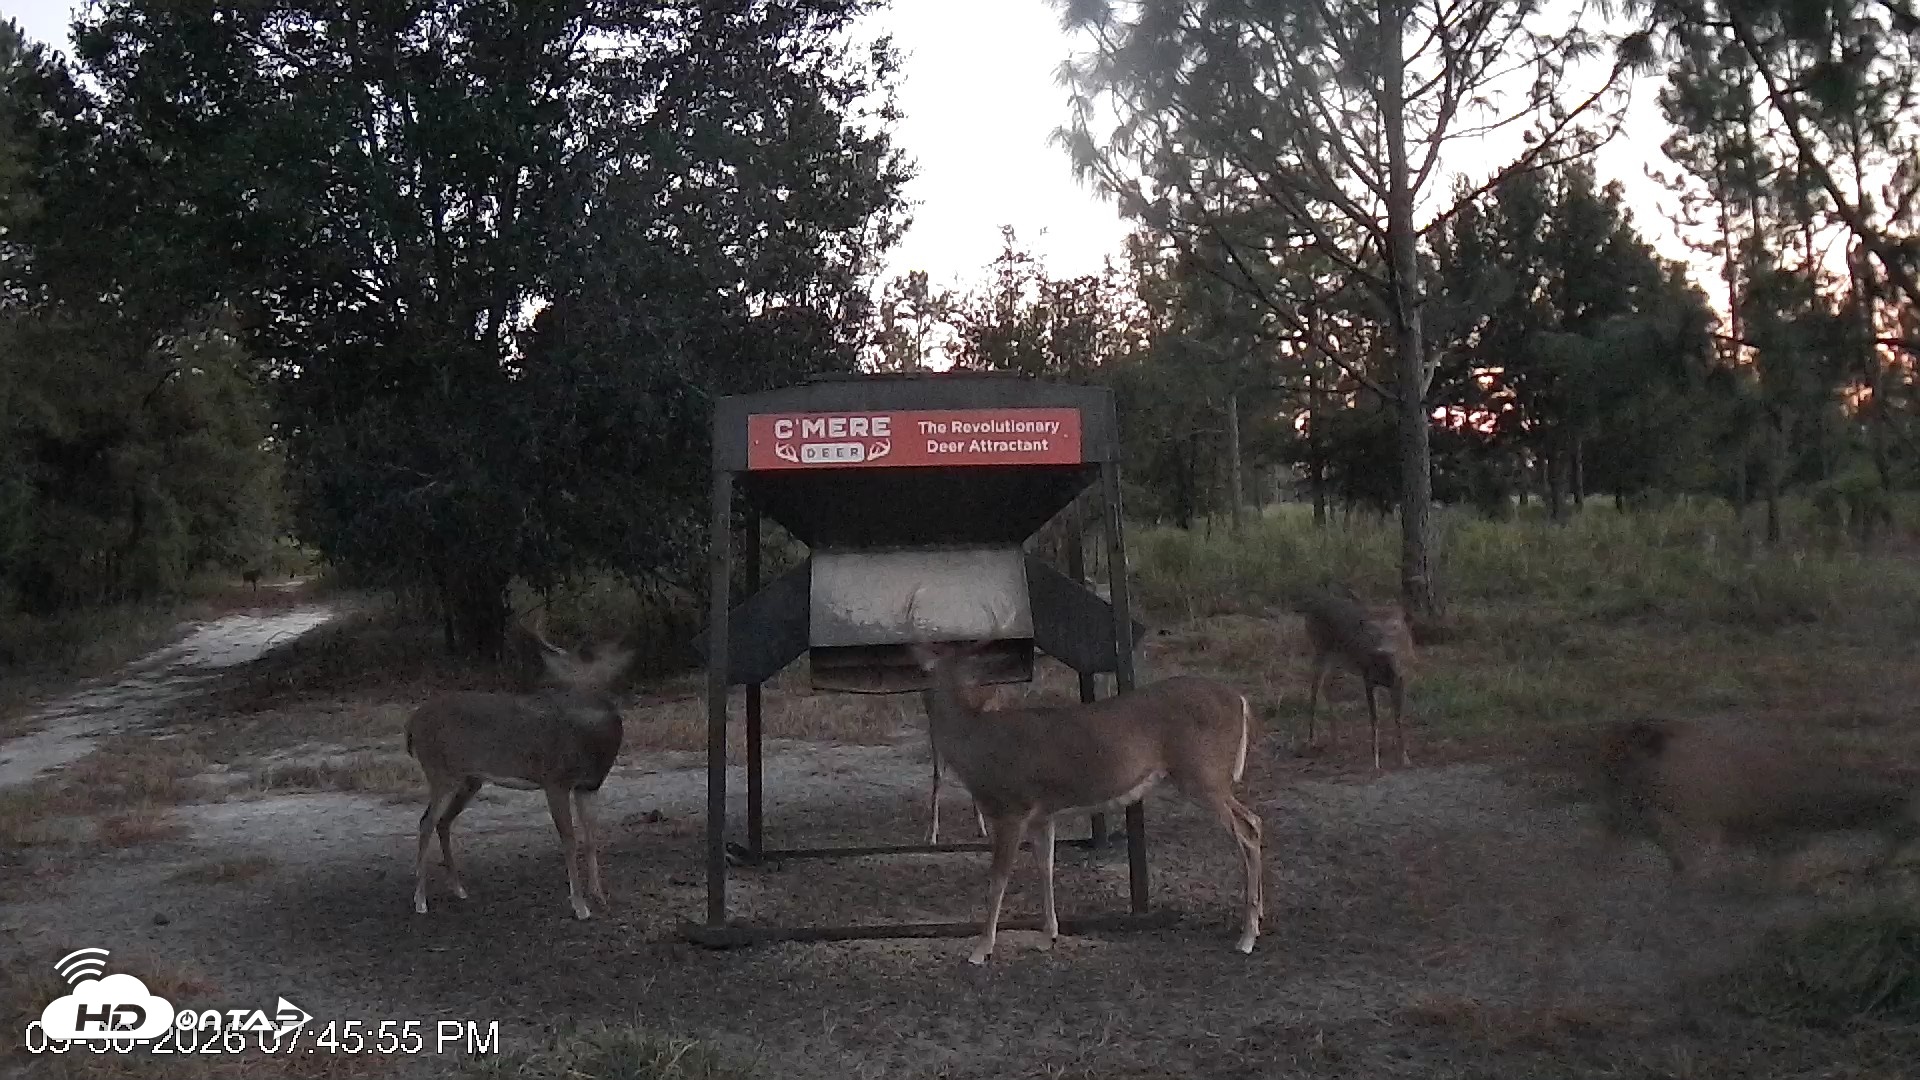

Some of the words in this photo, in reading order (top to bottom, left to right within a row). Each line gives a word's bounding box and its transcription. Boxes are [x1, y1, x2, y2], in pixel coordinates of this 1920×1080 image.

[774, 417, 891, 440] C'MERE
[918, 421, 949, 435] The
[951, 420, 1060, 437] Revolutionary
[806, 444, 859, 459] DEER
[926, 439, 965, 453] Deer
[969, 437, 1049, 453] Attractant
